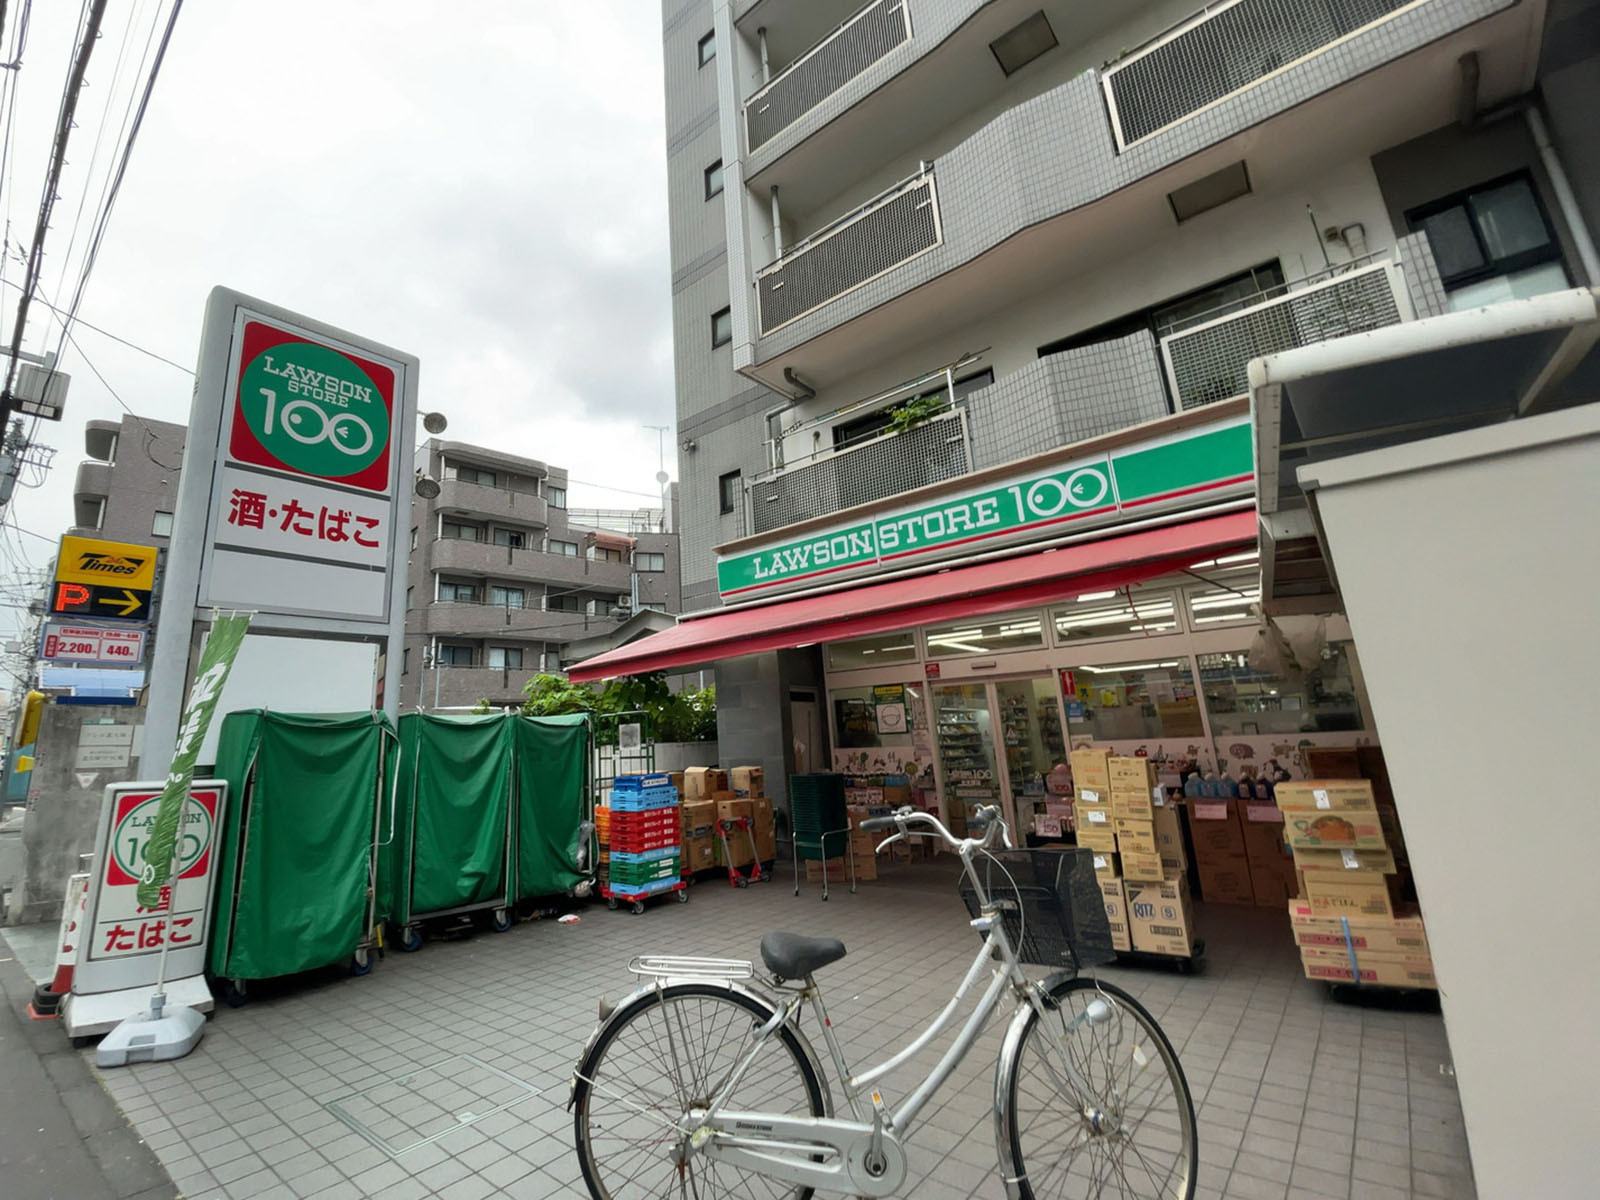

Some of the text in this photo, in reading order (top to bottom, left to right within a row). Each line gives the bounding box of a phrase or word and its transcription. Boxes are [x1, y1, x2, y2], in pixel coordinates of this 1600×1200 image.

[263, 356, 372, 403] LAWSON
[287, 380, 349, 408] STORE
[259, 388, 374, 456] 100
[227, 488, 381, 549] 酒・たばこ
[753, 467, 1109, 580] LAWSON STORE 100
[79, 553, 138, 575] Times
[56, 583, 90, 612] P
[131, 813, 202, 828] LAON
[1133, 902, 1154, 918] RITZ
[104, 917, 194, 952] たばこ
